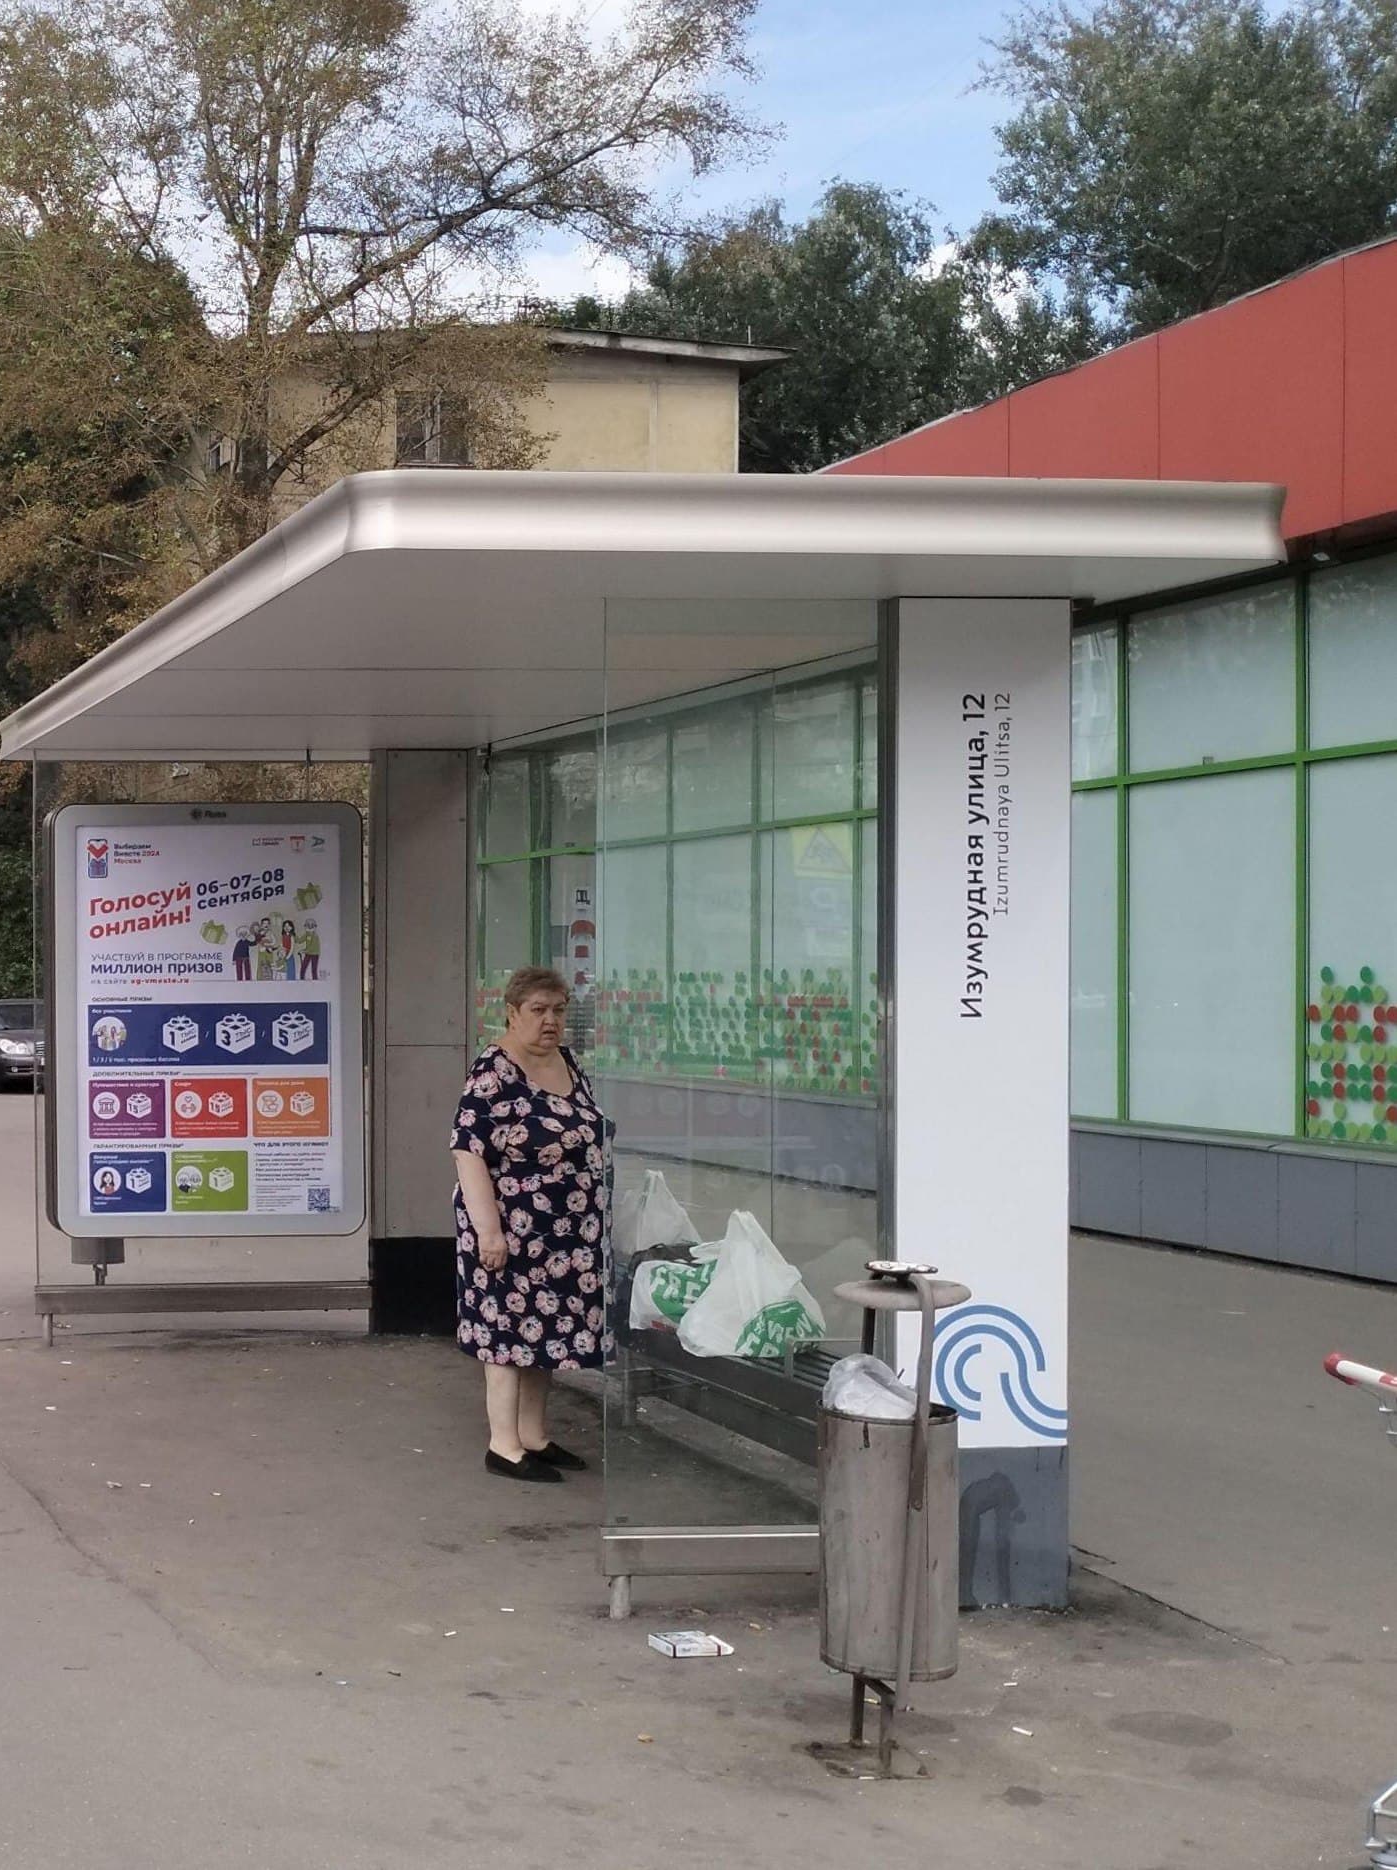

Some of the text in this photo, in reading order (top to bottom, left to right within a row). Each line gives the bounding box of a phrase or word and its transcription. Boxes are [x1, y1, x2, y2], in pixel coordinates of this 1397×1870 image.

[992, 692, 1013, 915] Izumrudnaya Ulitsa, 12
[960, 693, 990, 1018] Изумрудная улица, 12
[89, 881, 192, 916] Голосуй
[197, 883, 286, 910] сентября
[89, 904, 192, 940] онлайн!
[91, 951, 223, 961] УЧАСТВУЙ В ПРОГРАММЕ
[221, 1029, 231, 1047] 3
[278, 1028, 289, 1047] 5
